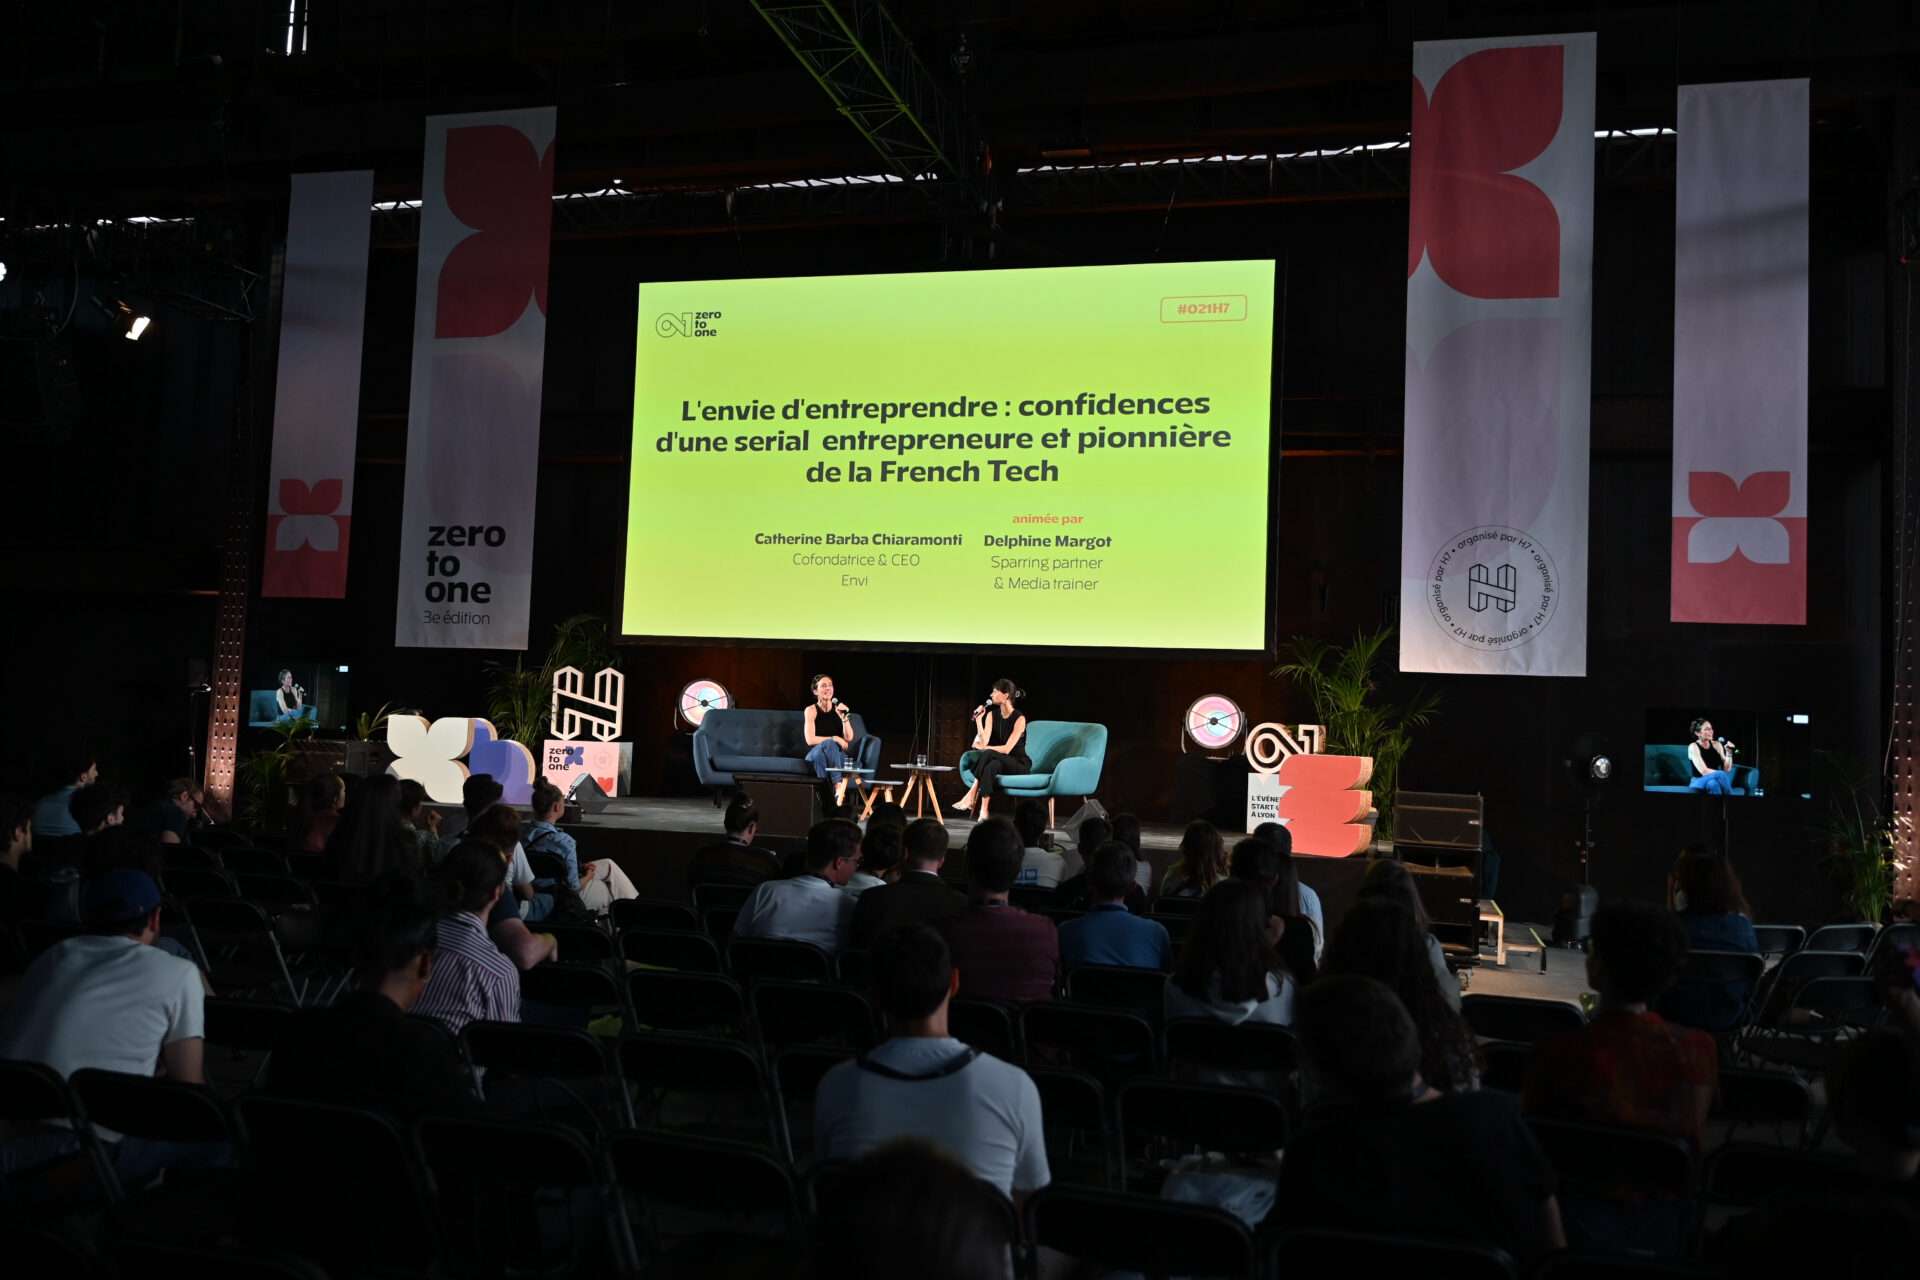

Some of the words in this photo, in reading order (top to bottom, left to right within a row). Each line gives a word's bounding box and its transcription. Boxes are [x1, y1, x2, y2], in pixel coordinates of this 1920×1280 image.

[695, 311, 721, 319] zero
[695, 320, 707, 328] to
[694, 329, 717, 337] one
[682, 400, 775, 421] L'envie
[781, 395, 997, 424] d'entreprendre
[1018, 392, 1210, 416] confidences
[656, 431, 728, 452] d'une
[734, 430, 809, 451] serial
[822, 428, 1033, 455] entrepreneure
[1041, 428, 1071, 448] et
[1078, 423, 1231, 454] pionnière
[806, 461, 841, 482] de
[849, 461, 872, 482] la
[880, 460, 980, 482] French
[987, 459, 1059, 482] Tech
[1012, 514, 1059, 524] animée
[1061, 516, 1084, 525] par
[428, 525, 506, 547] zero
[755, 533, 822, 545] Catherine
[826, 534, 869, 545] Barba
[872, 534, 963, 546] Chiaramonti
[984, 534, 1051, 549] Delphine
[1055, 535, 1112, 550] Margot
[1457, 531, 1498, 550] organisé
[1500, 533, 1517, 544] par
[1518, 538, 1533, 550] H7
[426, 550, 460, 577] to
[792, 552, 875, 566] Cofondatrice
[878, 554, 887, 566] &
[891, 554, 920, 566] CEO
[991, 555, 1049, 571] Sparring
[1052, 557, 1103, 571] partner
[1440, 551, 1453, 565] H7
[841, 574, 868, 586] Envi
[1434, 565, 1446, 582] par
[1532, 553, 1554, 594] organisé
[994, 577, 1004, 589] &
[1008, 577, 1050, 590] Media
[1053, 577, 1099, 590] trainer
[425, 581, 491, 603] one
[1432, 583, 1452, 623] organisé
[1541, 594, 1551, 613] par
[424, 610, 440, 624] 3e
[443, 609, 490, 625] édition
[1533, 612, 1546, 626] H7
[1453, 627, 1468, 639] H7
[1468, 633, 1486, 644] par
[1487, 627, 1528, 646] organisé
[549, 747, 574, 755] zero
[548, 755, 560, 763] to
[548, 763, 570, 771] one
[1251, 803, 1274, 811] START
